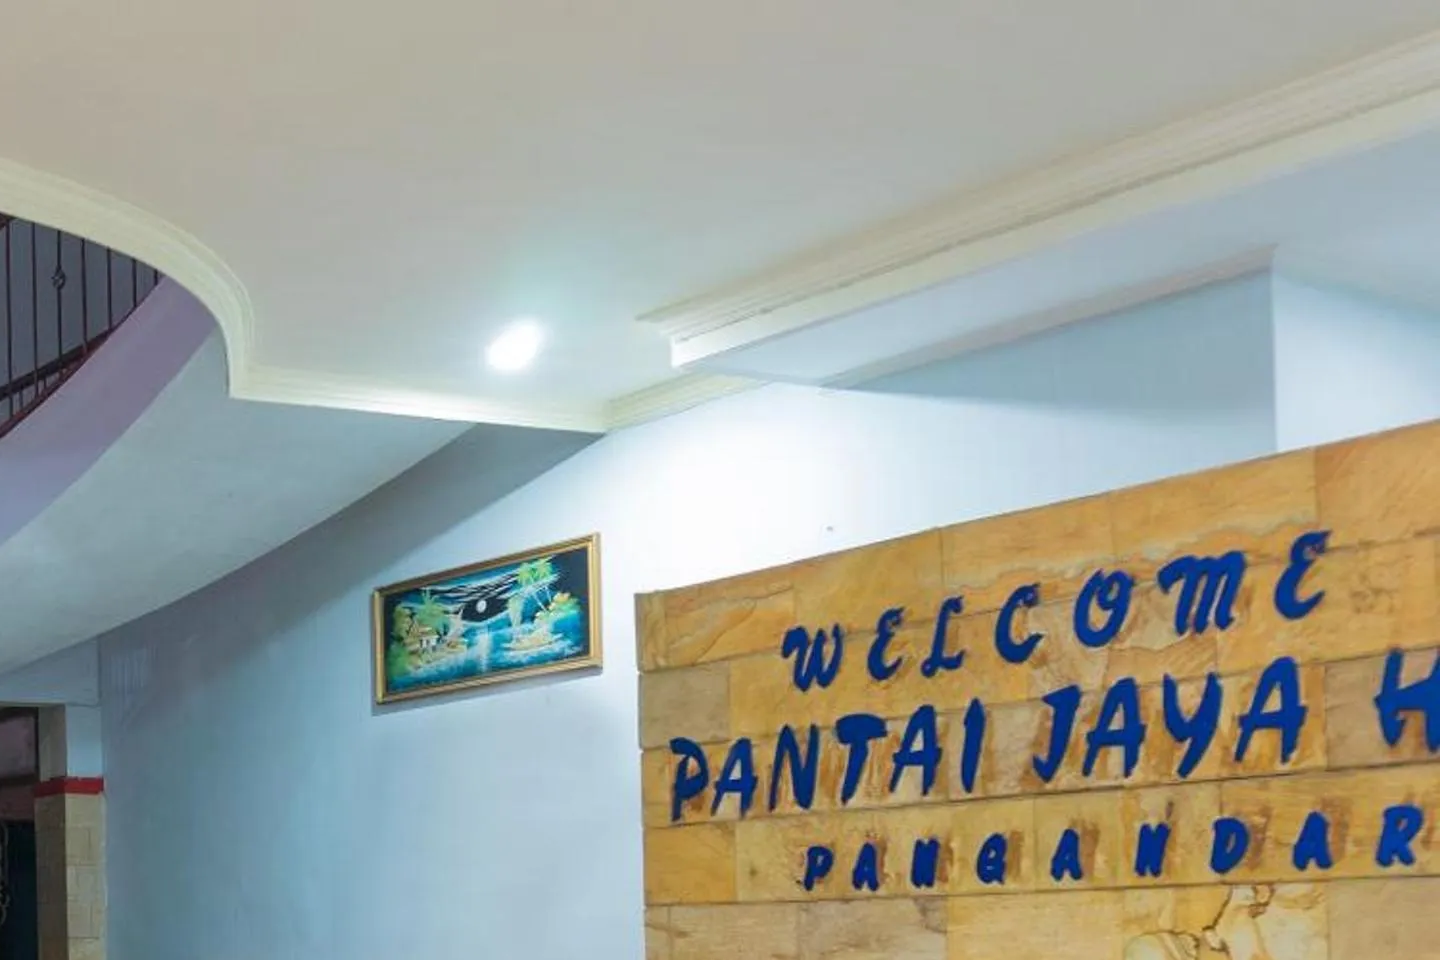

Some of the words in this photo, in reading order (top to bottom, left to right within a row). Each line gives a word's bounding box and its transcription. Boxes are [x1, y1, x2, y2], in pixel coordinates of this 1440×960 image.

[780, 528, 1333, 693] WELCOME
[668, 696, 988, 822] PANTAI
[1031, 655, 1309, 780] JAYA
[801, 803, 1425, 892] PANGANDAR
